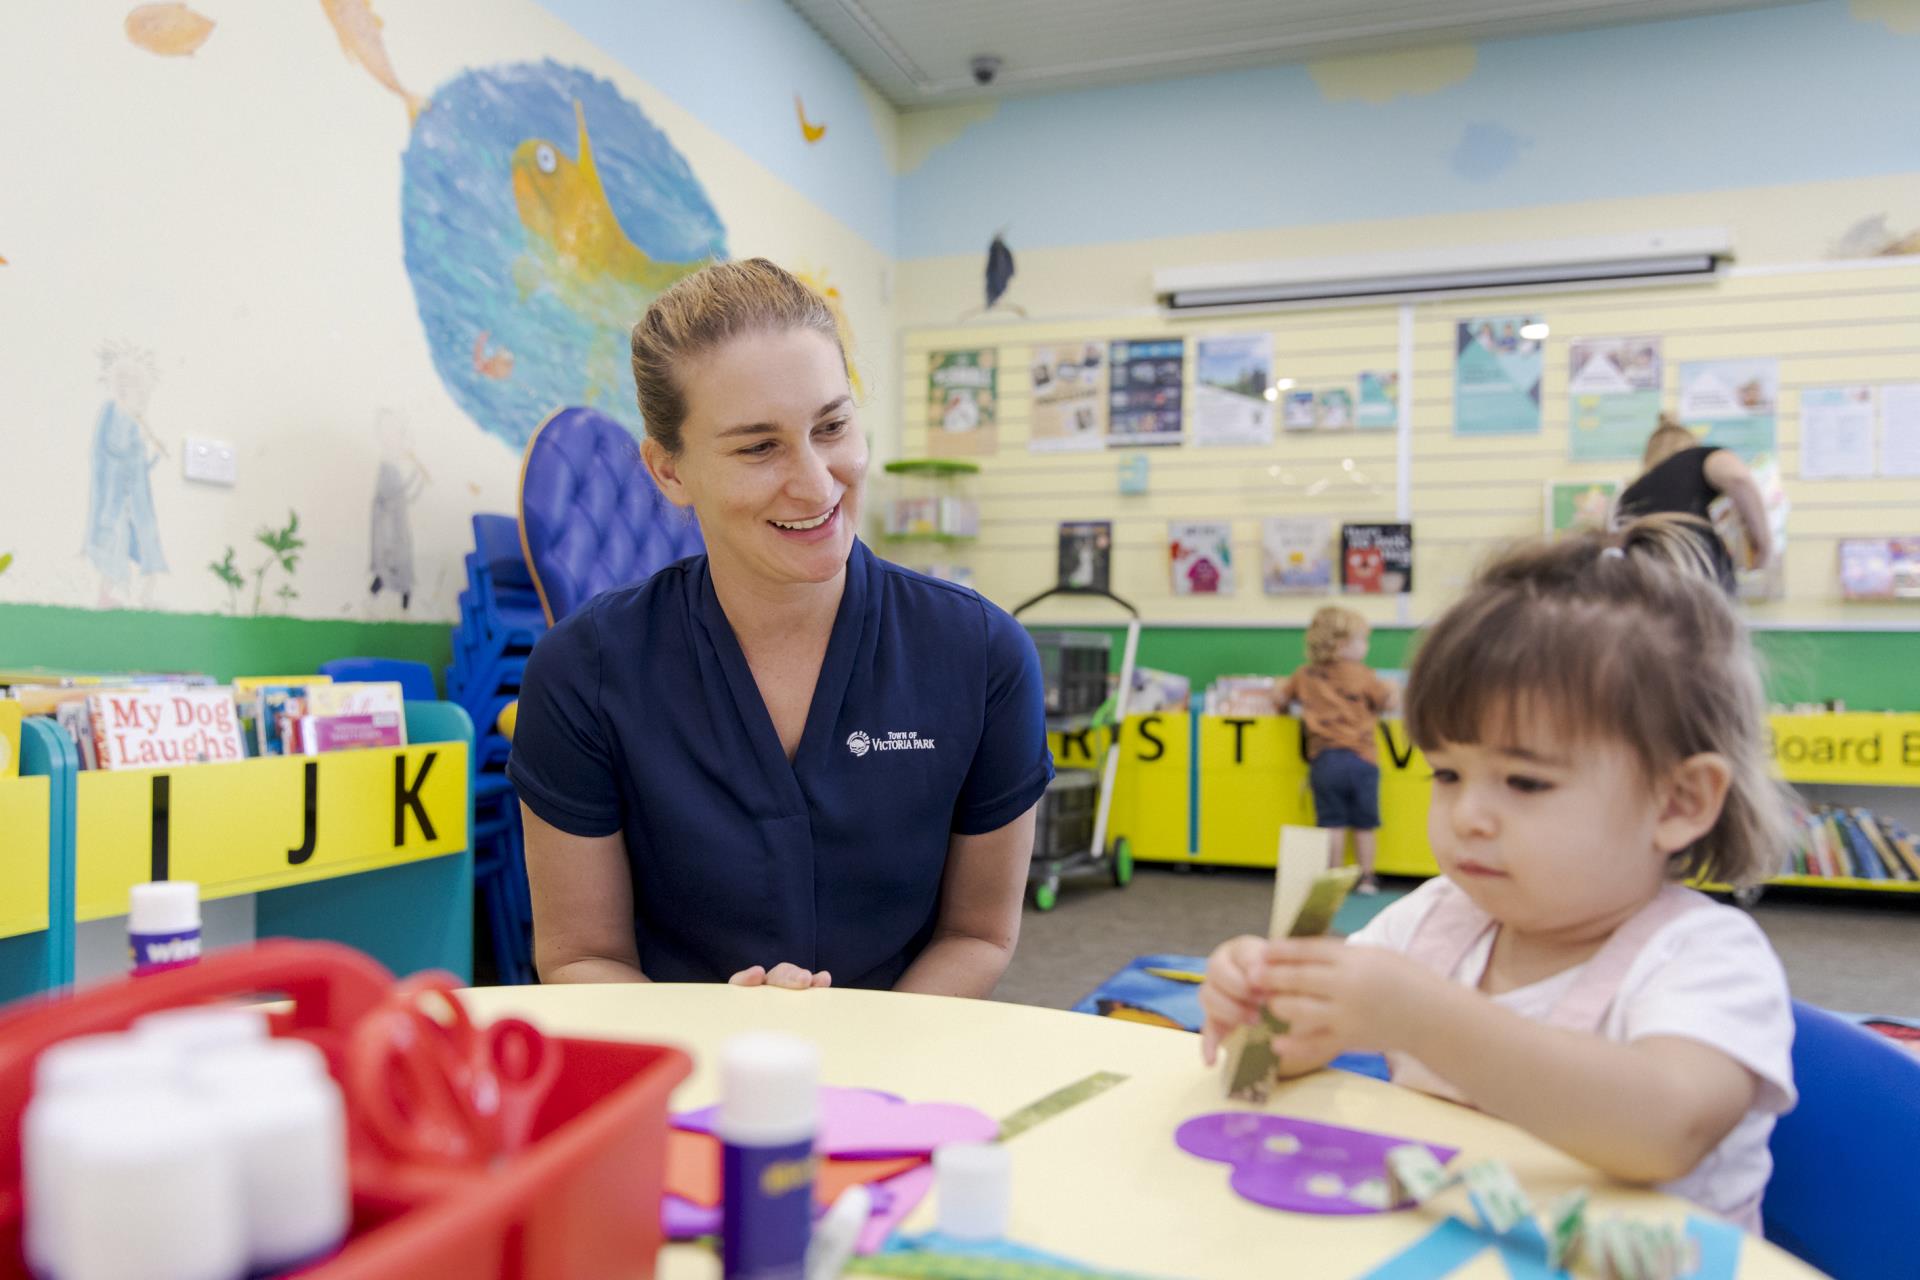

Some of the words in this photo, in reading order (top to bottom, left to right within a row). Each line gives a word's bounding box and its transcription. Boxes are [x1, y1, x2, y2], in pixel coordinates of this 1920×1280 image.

[110, 698, 161, 735] My
[170, 697, 233, 733] Dog
[888, 731, 907, 739] TOWN
[908, 731, 918, 739] OF
[115, 728, 237, 764] Laughs
[871, 738, 913, 751] VICTORIA
[913, 738, 935, 749] PARK
[1138, 716, 1165, 761] S
[1223, 719, 1256, 764] T
[287, 762, 317, 865] J
[394, 752, 438, 847] K
